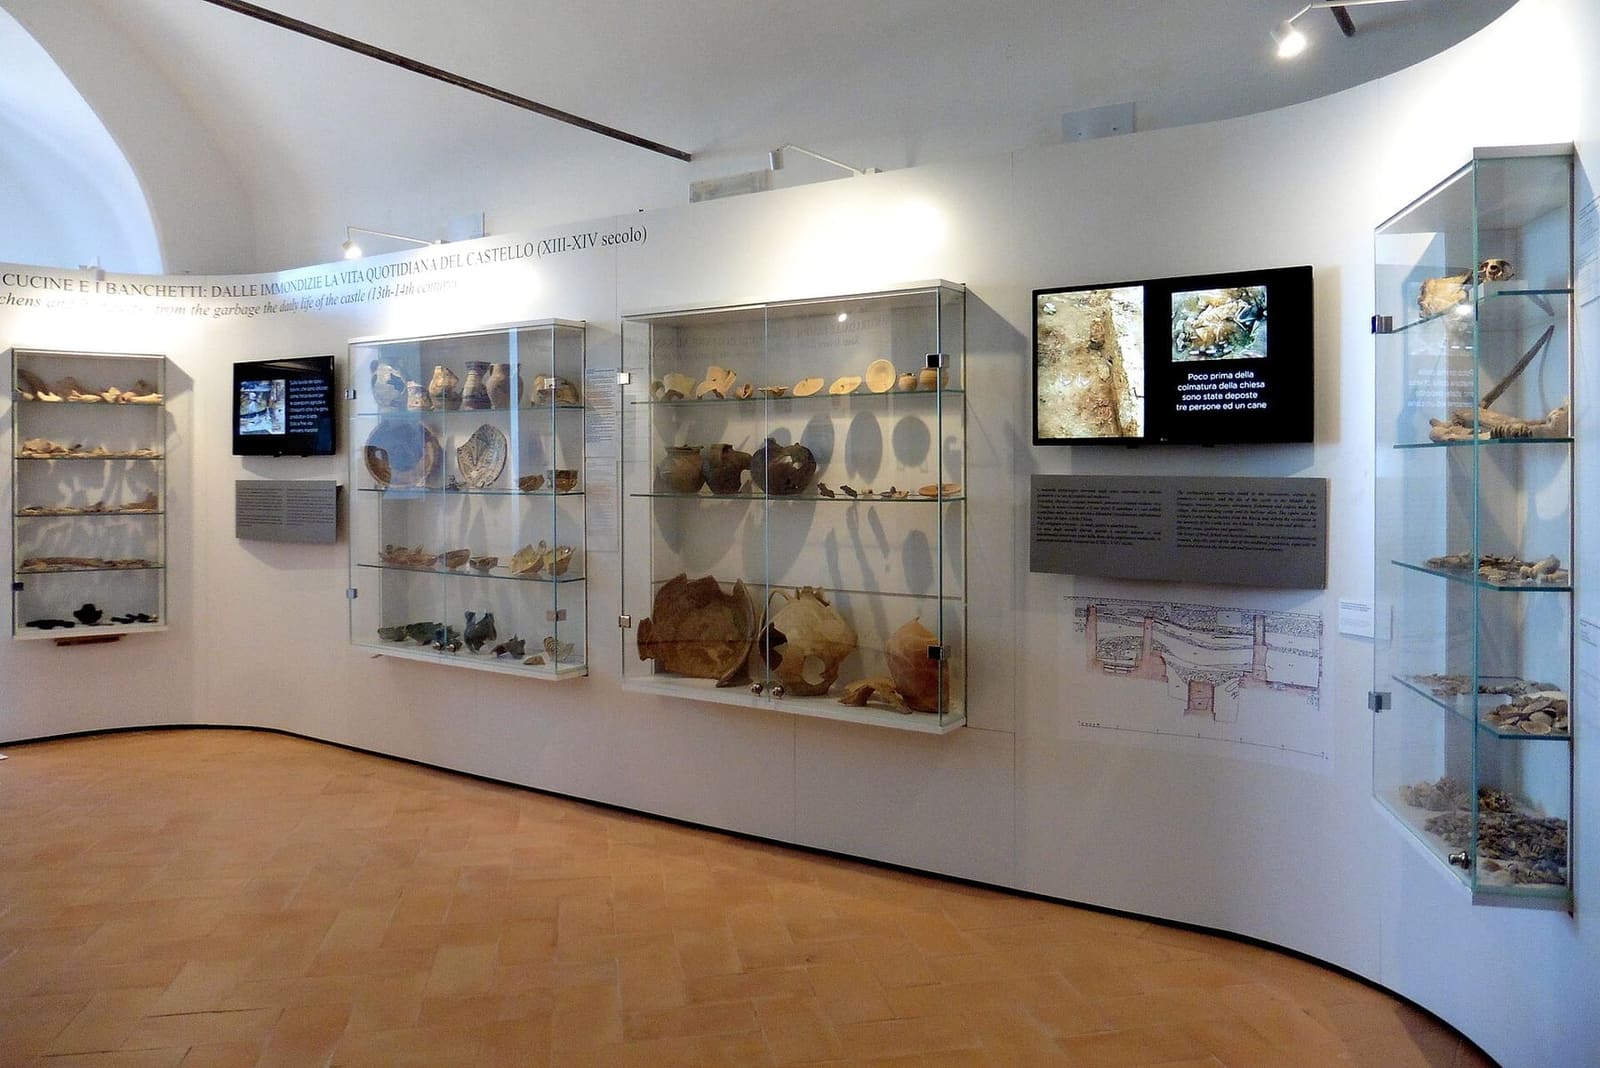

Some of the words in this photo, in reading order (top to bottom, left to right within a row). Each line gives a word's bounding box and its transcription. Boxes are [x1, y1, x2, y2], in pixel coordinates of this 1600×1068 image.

[2, 273, 73, 291] CUCINE
[79, 280, 89, 293] E
[106, 282, 207, 298] BANCHETTI:
[212, 285, 257, 298] DALLE
[260, 276, 323, 296] IMMONDIZIE
[325, 273, 339, 288] LA
[340, 271, 364, 285] VITA
[366, 259, 437, 284] QUOTIDIANA
[440, 254, 463, 269] DEL
[466, 242, 534, 266] CASTELLO
[537, 232, 598, 259] (XIII-XIV
[601, 225, 647, 247] secolo)
[191, 304, 210, 316] the
[214, 303, 259, 318] garbage
[263, 302, 277, 314] the
[280, 299, 298, 314] daily
[300, 295, 313, 311] life
[315, 294, 325, 310] of
[325, 292, 336, 306] the
[340, 288, 365, 305] castle
[367, 281, 414, 301] (13th-14th
[1188, 373, 1208, 381] Poco
[1210, 371, 1233, 381] prima
[1234, 370, 1254, 379] della
[1218, 381, 1238, 389] della
[1239, 380, 1266, 388] chiesa
[1203, 392, 1223, 400] state
[1225, 391, 1258, 400] deposte
[1189, 403, 1221, 411] persone
[1223, 402, 1233, 410] ed
